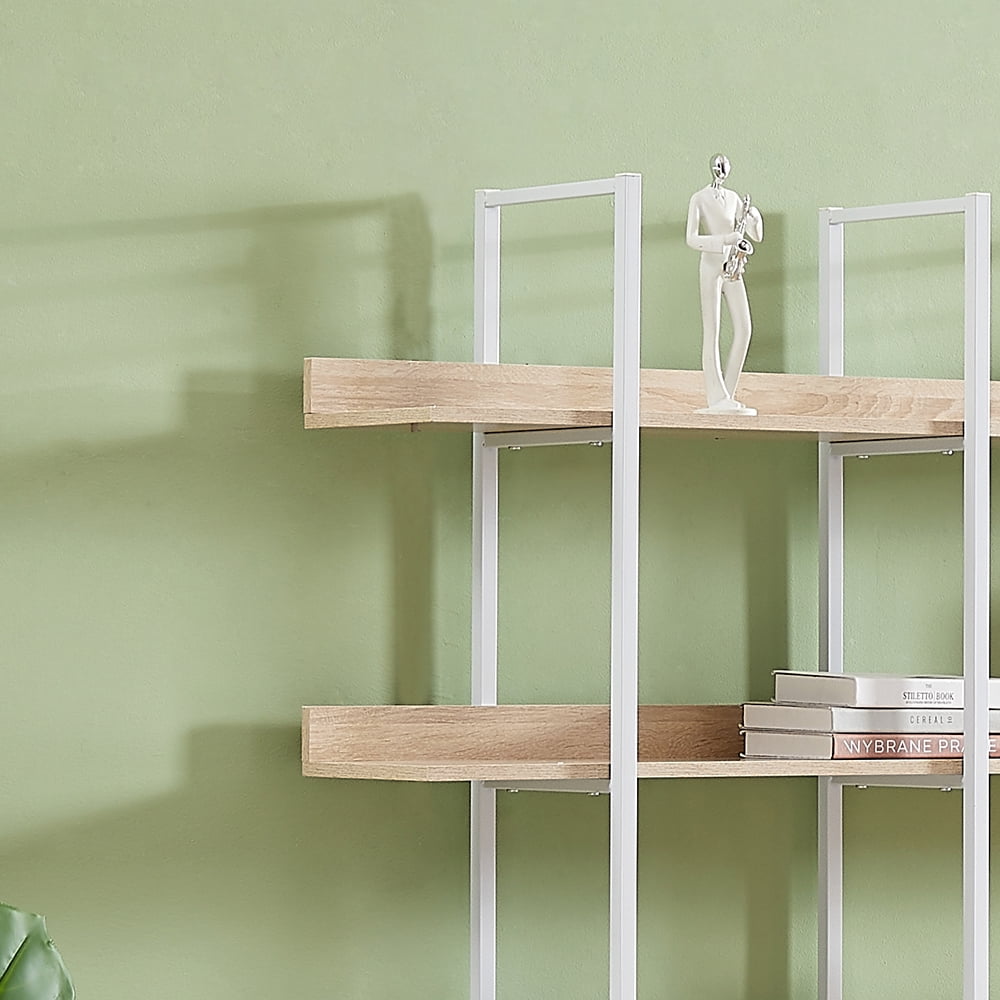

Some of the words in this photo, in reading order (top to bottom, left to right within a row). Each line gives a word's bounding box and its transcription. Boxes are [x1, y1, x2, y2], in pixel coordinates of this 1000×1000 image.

[902, 691, 934, 700] STILETTO
[936, 691, 955, 700] BOOK
[910, 715, 944, 724] CEREAL
[843, 739, 932, 753] WYBRANE
